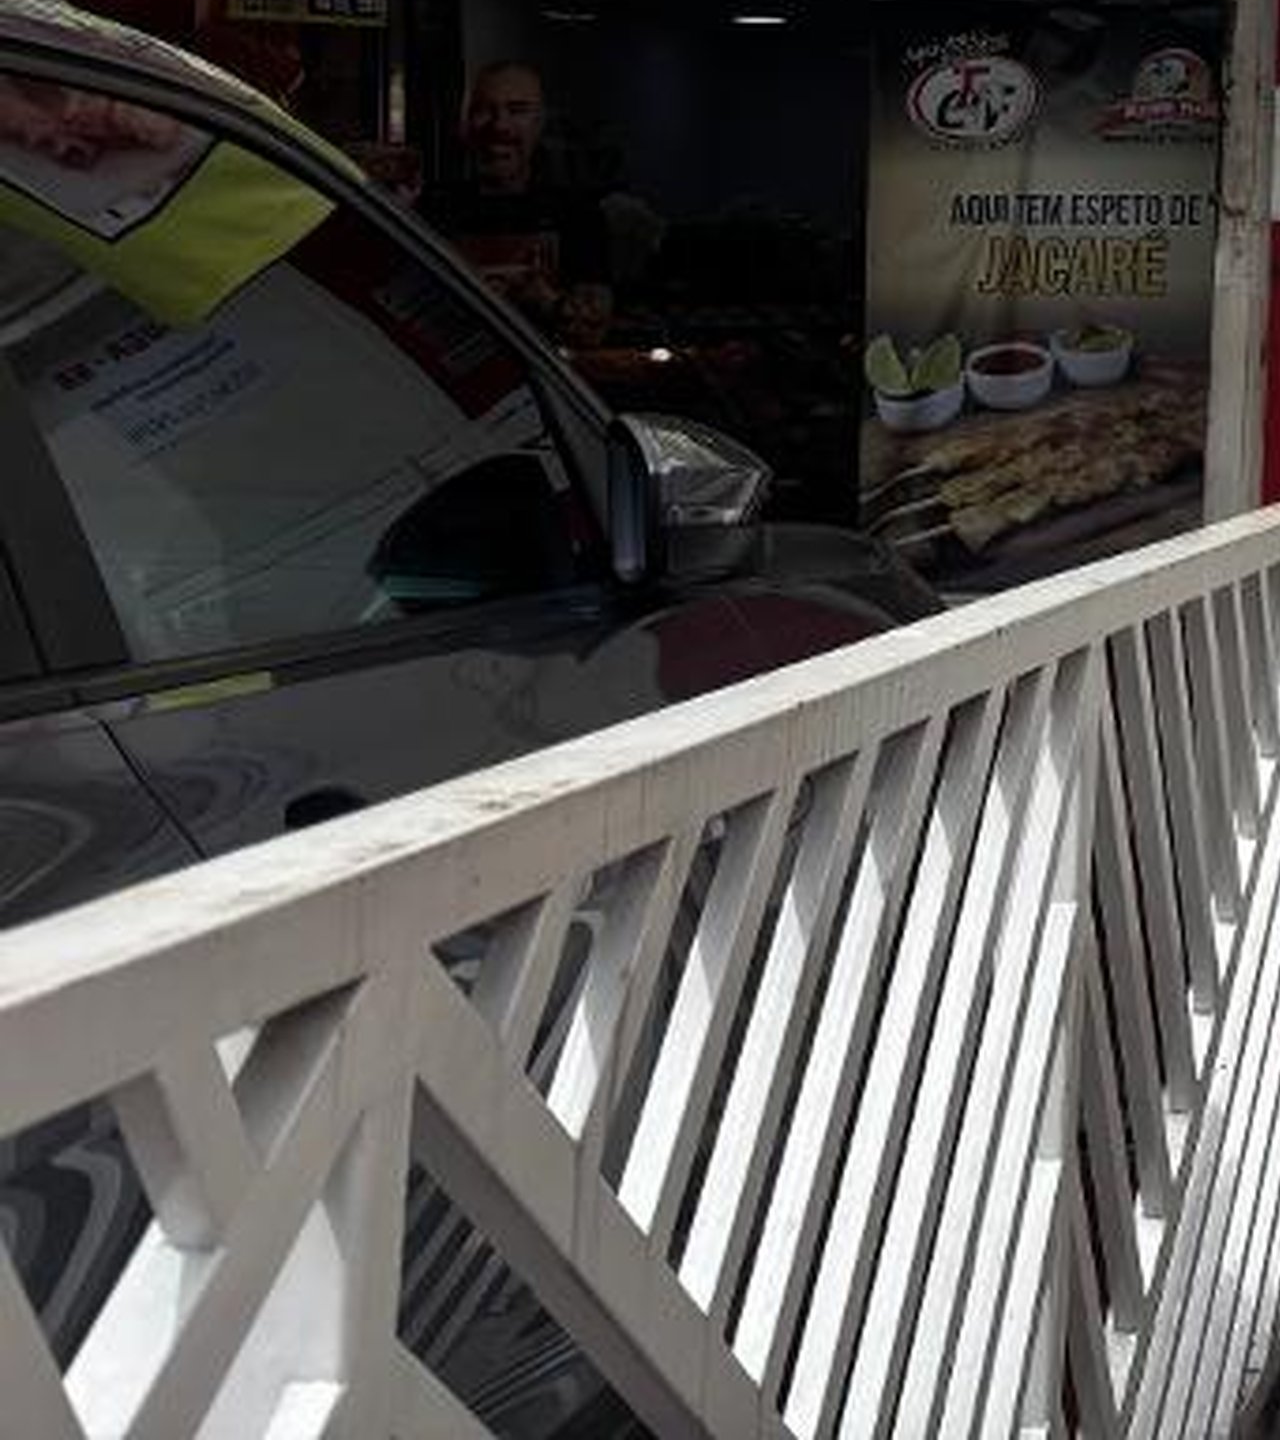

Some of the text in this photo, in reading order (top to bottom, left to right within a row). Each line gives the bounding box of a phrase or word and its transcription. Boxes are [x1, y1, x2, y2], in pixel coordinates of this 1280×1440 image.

[950, 194, 1202, 228] AQUI TEM ESPETO DE
[977, 229, 1169, 298] JACARÉ
